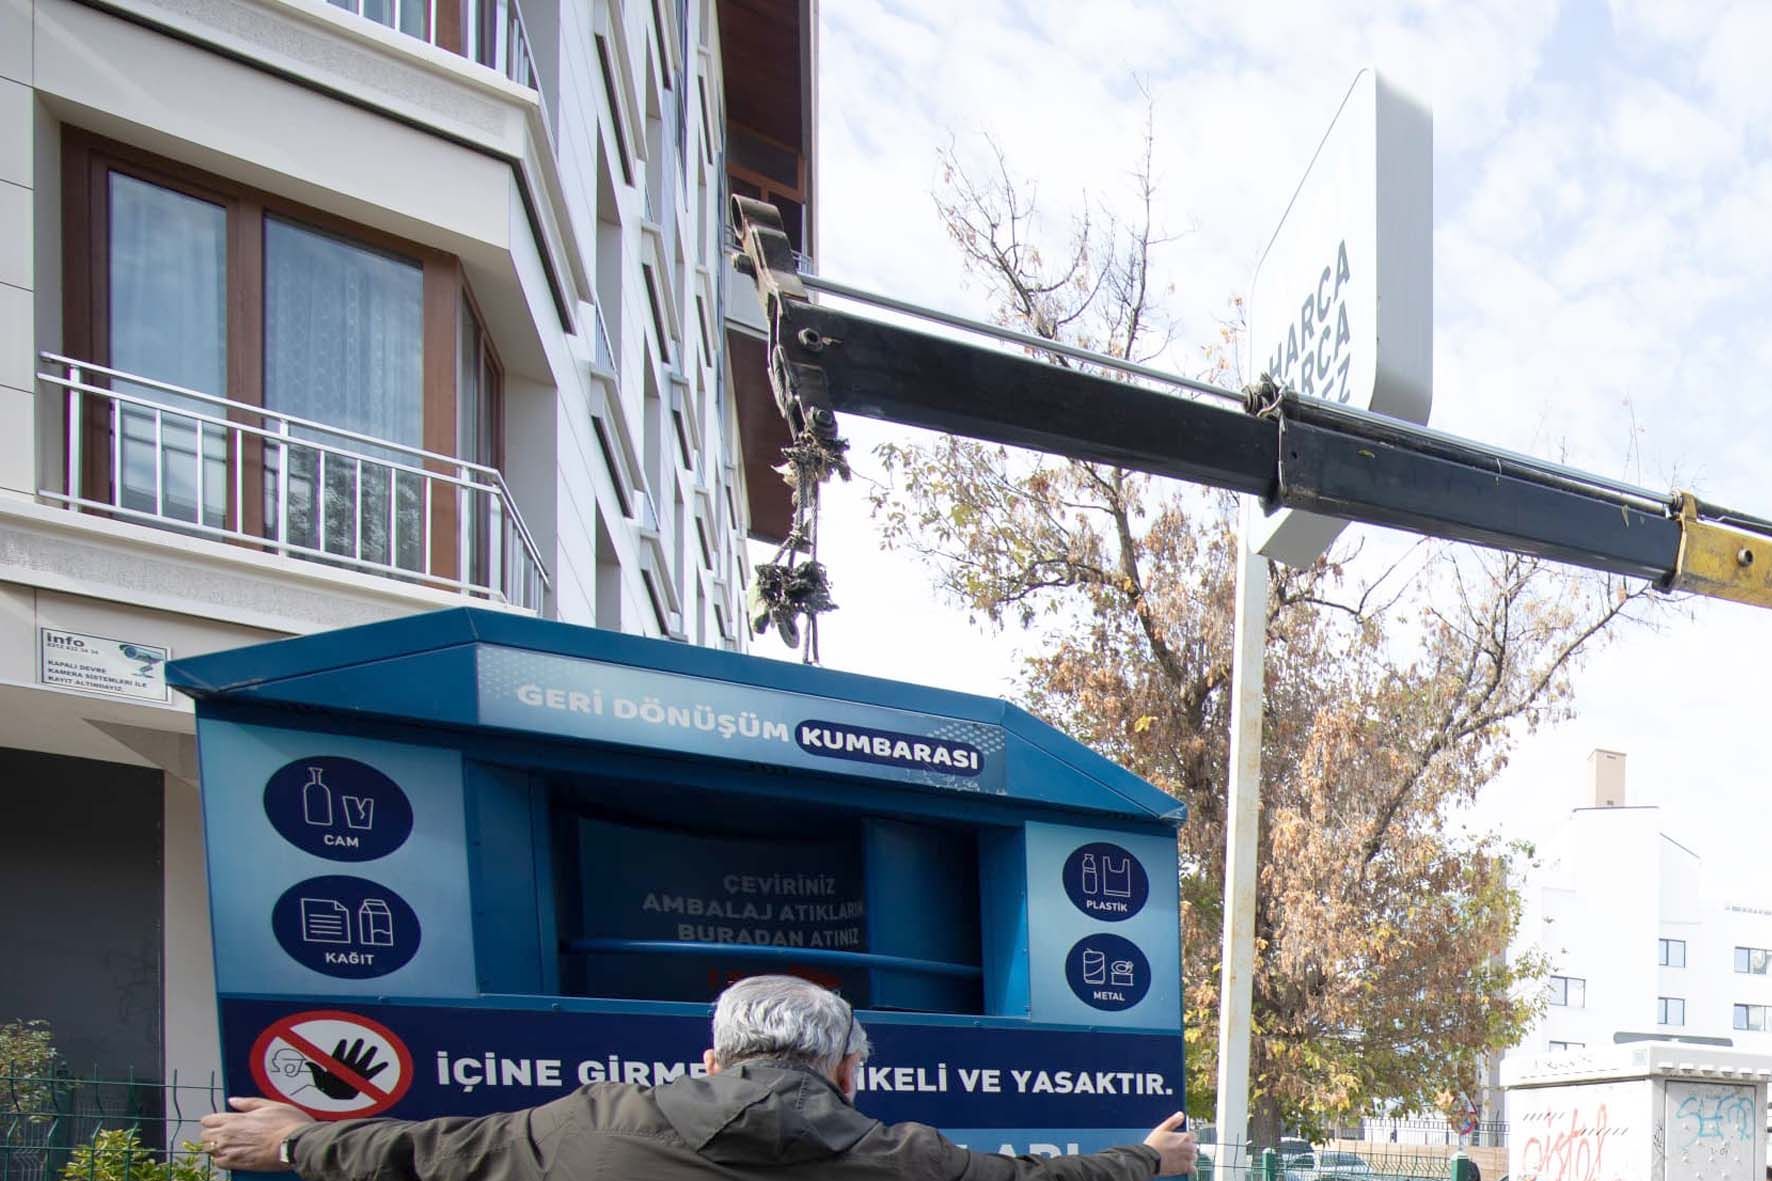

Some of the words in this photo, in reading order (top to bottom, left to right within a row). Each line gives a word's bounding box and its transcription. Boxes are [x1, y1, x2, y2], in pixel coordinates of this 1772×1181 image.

[46, 631, 86, 648] info
[517, 682, 602, 715] GERİ
[613, 696, 790, 743] DÖNÜŞÜM
[802, 726, 978, 770] KUMBARASI
[324, 834, 360, 848] CAM
[723, 873, 836, 896] ÇEVİRİNİZ
[642, 892, 774, 921] AMBALAJ
[1086, 899, 1129, 913] PLASTİK
[677, 923, 804, 947] BURADAN
[810, 927, 860, 948] ATINIZ
[325, 952, 375, 966] KAĞIT
[1093, 991, 1126, 1002] METAL
[437, 1051, 563, 1093] İÇİNE
[577, 1055, 707, 1087] GİRME
[857, 1063, 947, 1092] İKELİ
[958, 1068, 1001, 1093] VE
[1011, 1070, 1174, 1095] YASAKTIR.
